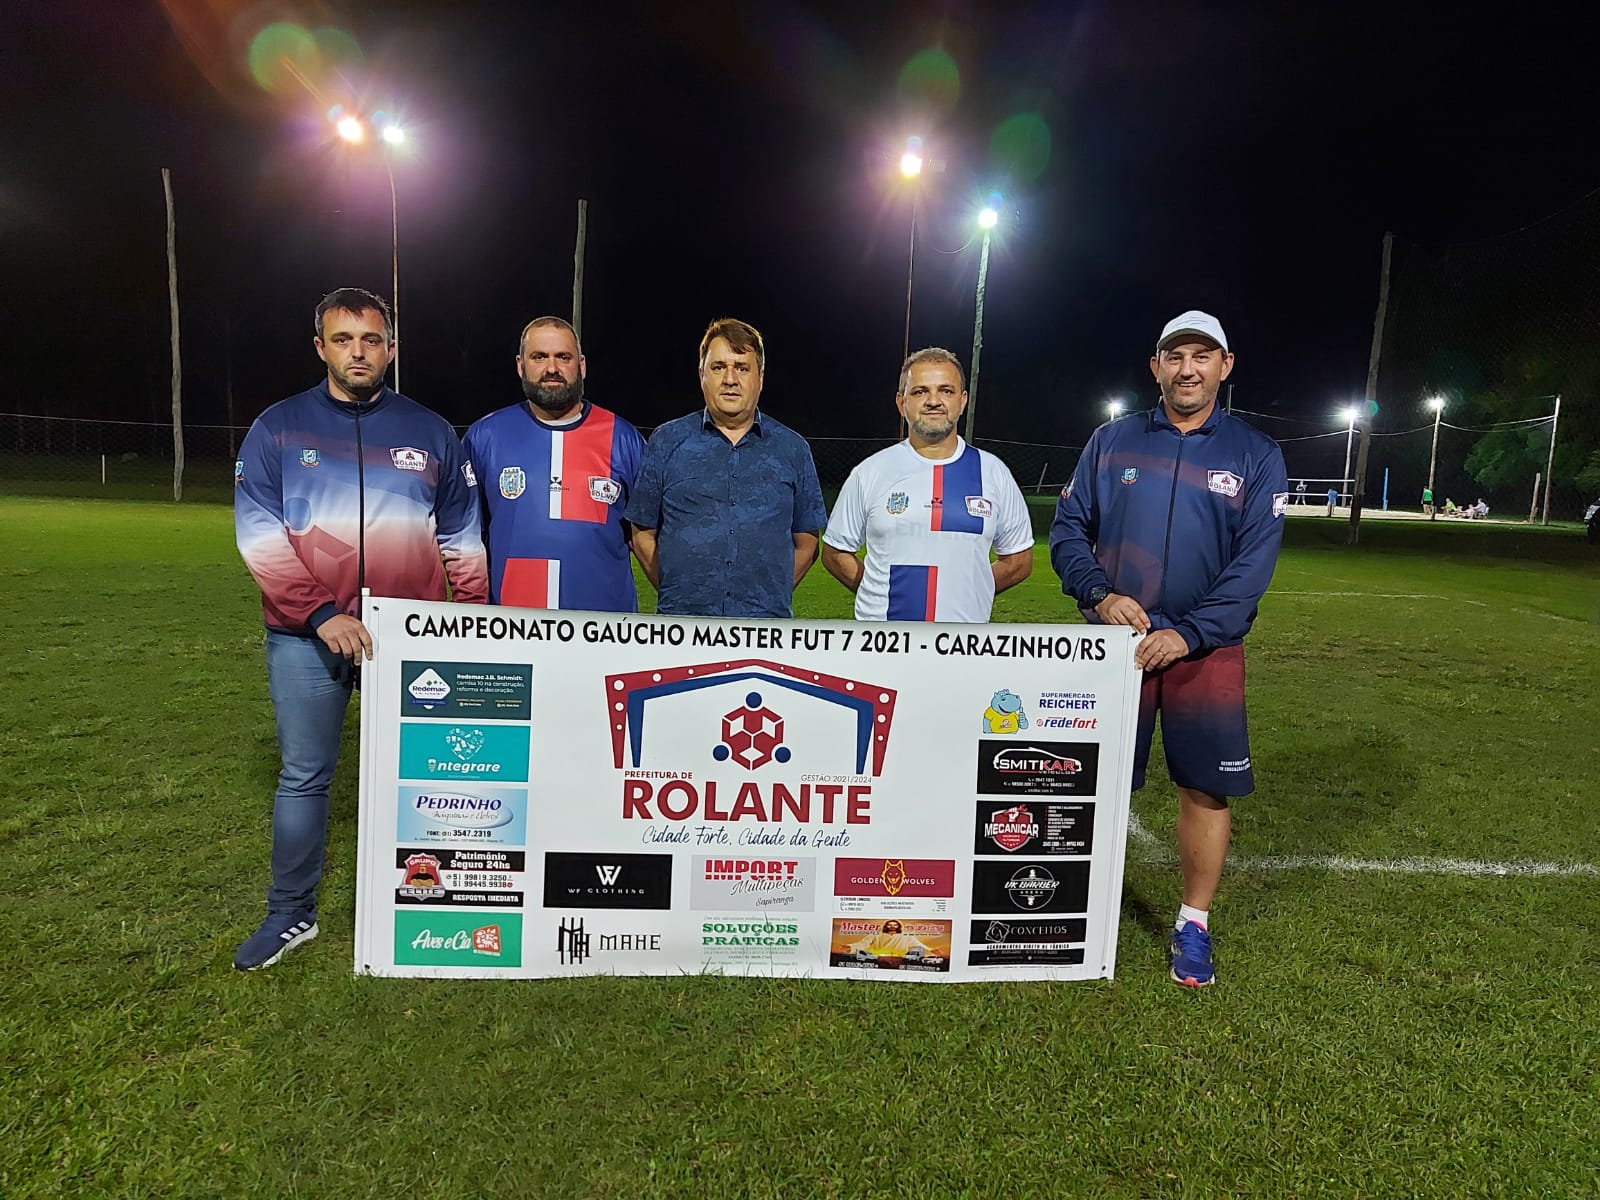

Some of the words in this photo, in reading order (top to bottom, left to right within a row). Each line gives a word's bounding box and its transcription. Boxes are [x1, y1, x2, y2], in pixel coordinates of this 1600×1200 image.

[405, 613, 575, 642] CAMPEONATO
[582, 617, 685, 645] GAÚCHO
[692, 625, 783, 648] MASTER
[791, 628, 835, 651] FUT
[841, 630, 854, 651] 7
[860, 630, 910, 653] 2021
[934, 633, 1106, 662] CARAZINHO/RS
[412, 685, 447, 693] Redemac
[1039, 699, 1097, 710] REICHERT
[999, 759, 1077, 771] SMITKAR
[624, 770, 678, 779] PREFEITURA
[681, 772, 693, 780] DE
[801, 774, 831, 782] GESTÃO
[833, 775, 872, 784] 2021/2024
[416, 796, 502, 811] PEDRINHO
[622, 779, 872, 825] ROLANTE
[984, 822, 1039, 838] MECANICAR
[642, 825, 691, 844] Cidade
[739, 827, 786, 846] Cidade
[789, 828, 808, 846] da
[811, 828, 851, 848] Gente
[409, 858, 437, 866] GRUPO
[455, 851, 507, 861] Patrimônio
[450, 860, 484, 870] Seguro
[486, 861, 511, 869] 24hs
[705, 859, 799, 881] IMPORT
[702, 922, 798, 936] SOLUÇÕES
[841, 921, 880, 931] Master
[1011, 925, 1068, 935] CONCEITOS
[411, 929, 444, 950] Aves
[452, 931, 472, 950] Cia
[599, 934, 661, 951] MAHE
